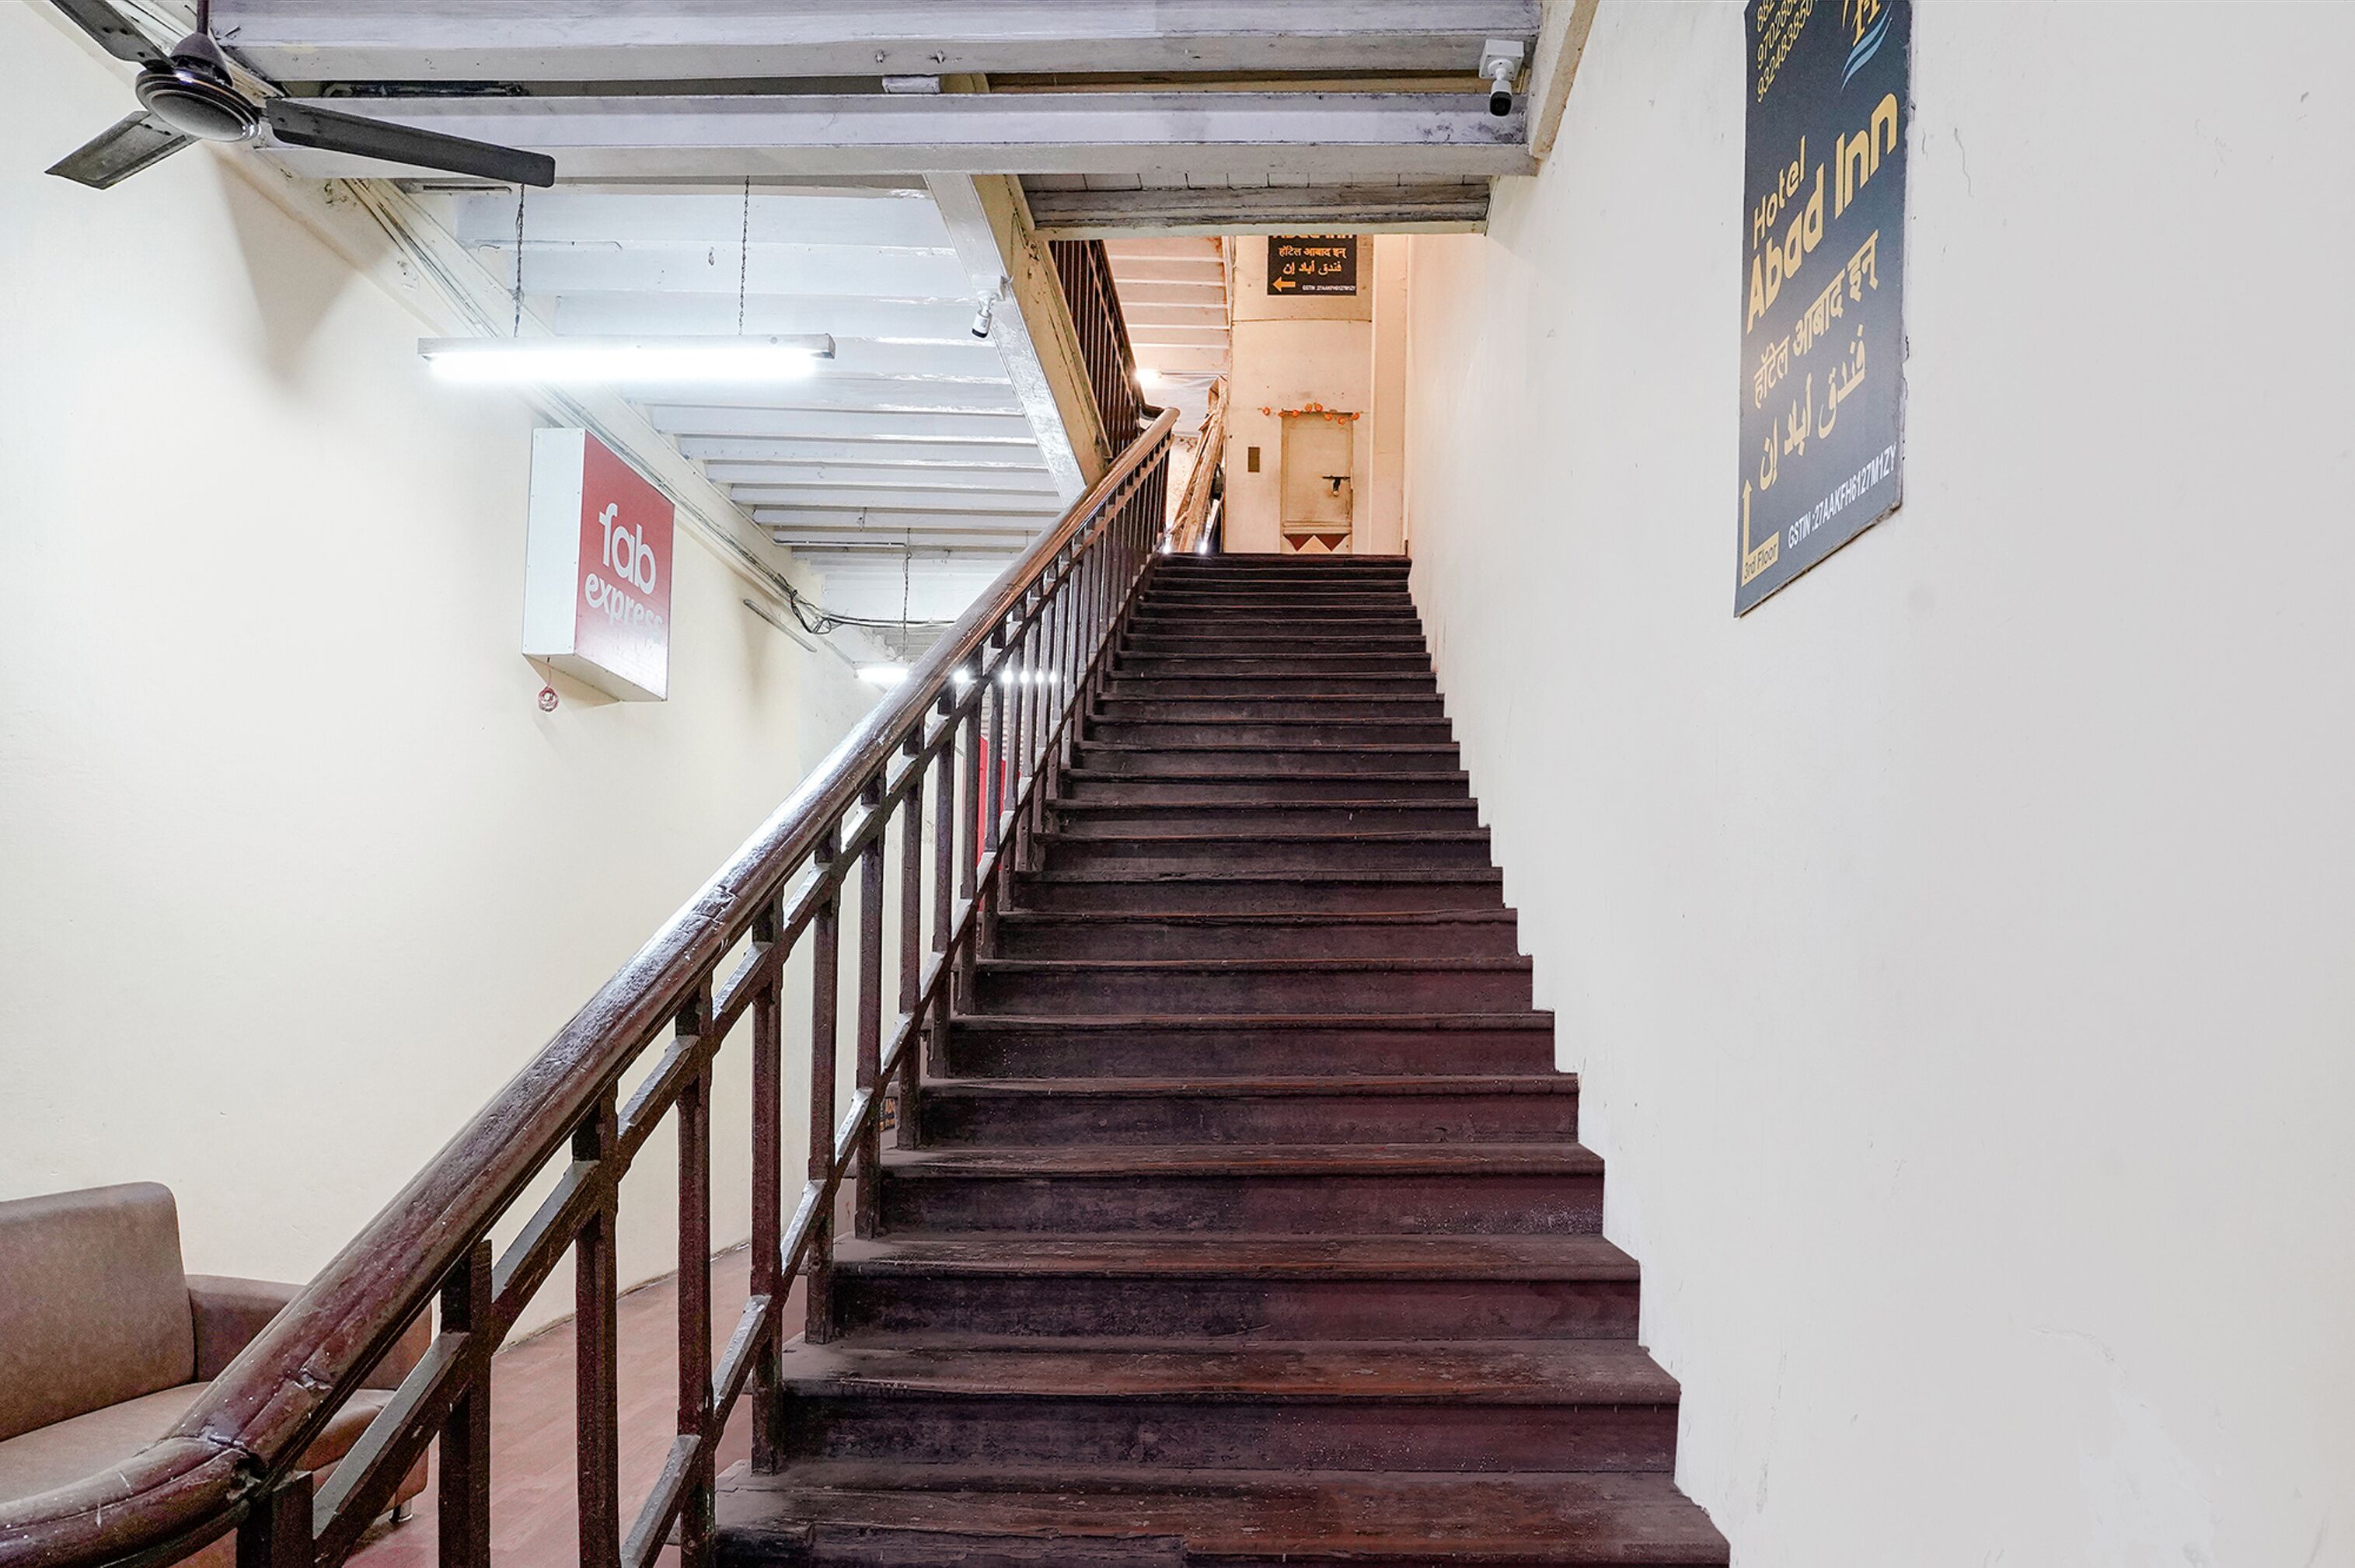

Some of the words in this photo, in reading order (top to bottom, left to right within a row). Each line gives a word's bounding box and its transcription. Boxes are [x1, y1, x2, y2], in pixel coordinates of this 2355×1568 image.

[1746, 162, 1824, 334] Abad
[1834, 92, 1898, 220] Inn
[1753, 135, 1806, 249] Hotel
[1792, 268, 1846, 357] आबाद
[598, 502, 657, 595] fab
[1743, 555, 1757, 580] 3rd
[1757, 542, 1778, 570] Floor
[1788, 510, 1812, 549] GSTIN
